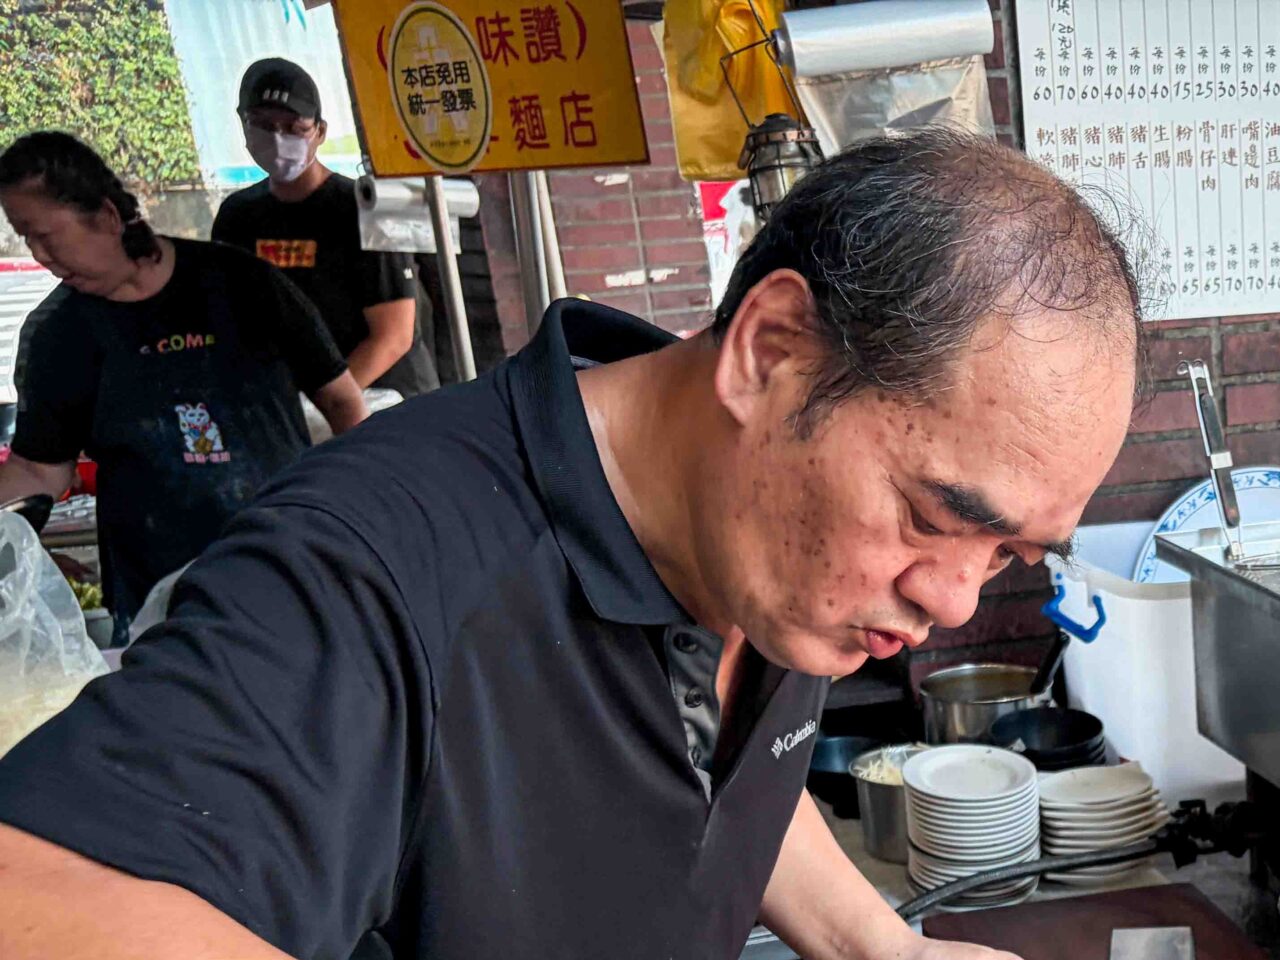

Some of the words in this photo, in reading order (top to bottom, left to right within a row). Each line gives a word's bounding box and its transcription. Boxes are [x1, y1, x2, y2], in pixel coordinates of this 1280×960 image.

[402, 60, 471, 89] 本店免用
[407, 88, 477, 116] 統一發票
[1084, 126, 1102, 167] 豬心
[1130, 124, 1148, 169] 豬舌
[1153, 125, 1171, 169] 生腸
[1176, 125, 1193, 168] 粉腸
[1199, 120, 1216, 191] 骨仔肉
[1221, 124, 1238, 166] 肝連
[1242, 121, 1260, 189] 嘴邊肉
[1265, 122, 1280, 191] 油豆腐
[783, 720, 816, 752] Columbia
